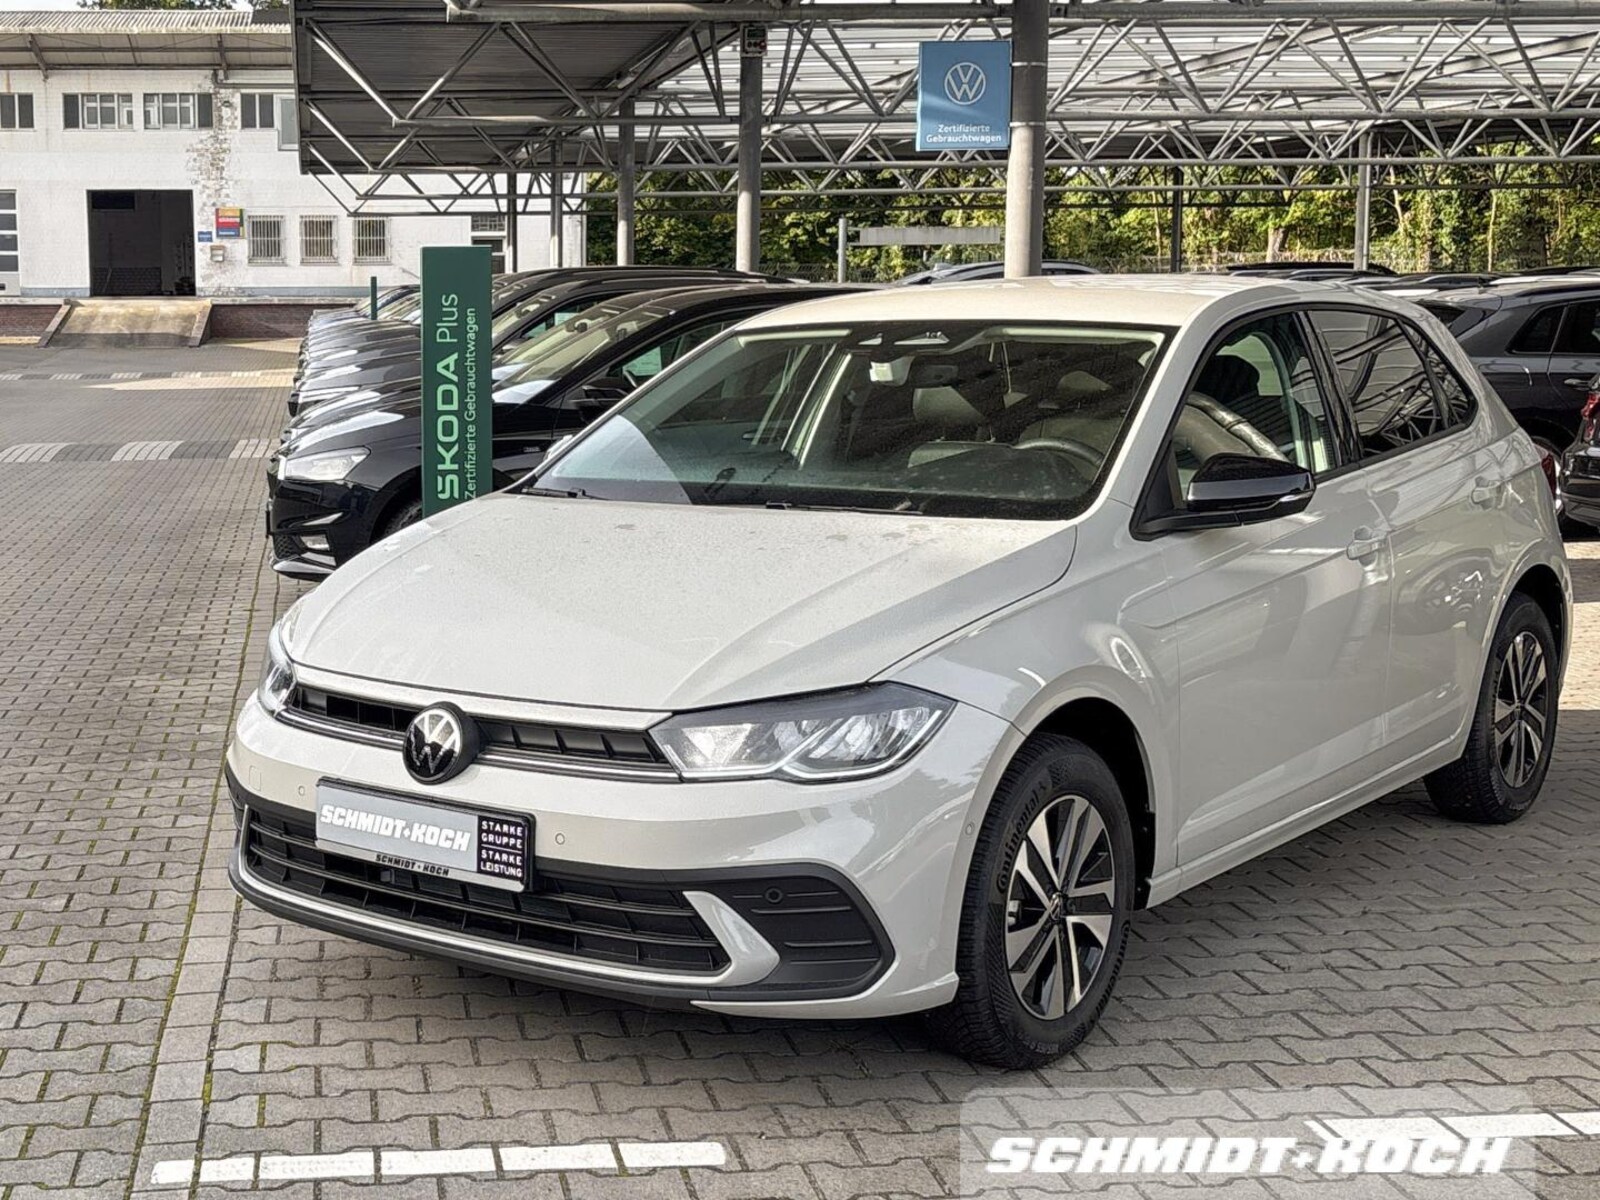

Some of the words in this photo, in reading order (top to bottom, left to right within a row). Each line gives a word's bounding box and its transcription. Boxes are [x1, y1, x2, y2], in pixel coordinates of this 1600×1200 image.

[938, 124, 990, 133] Zertifizierte
[926, 134, 1002, 144] Gebrauchtwagen
[436, 294, 459, 343] Plus
[464, 307, 478, 421] Gebrauchtwagen
[464, 424, 476, 500] Zertifizierte
[481, 820, 523, 837] STARKE
[481, 832, 522, 849] GRUPPE
[996, 793, 1040, 894] Continental
[376, 854, 416, 870] SCHMIDT
[423, 863, 450, 877] KOCH
[481, 849, 522, 866] STARKE
[480, 861, 522, 878] LEISTUNG
